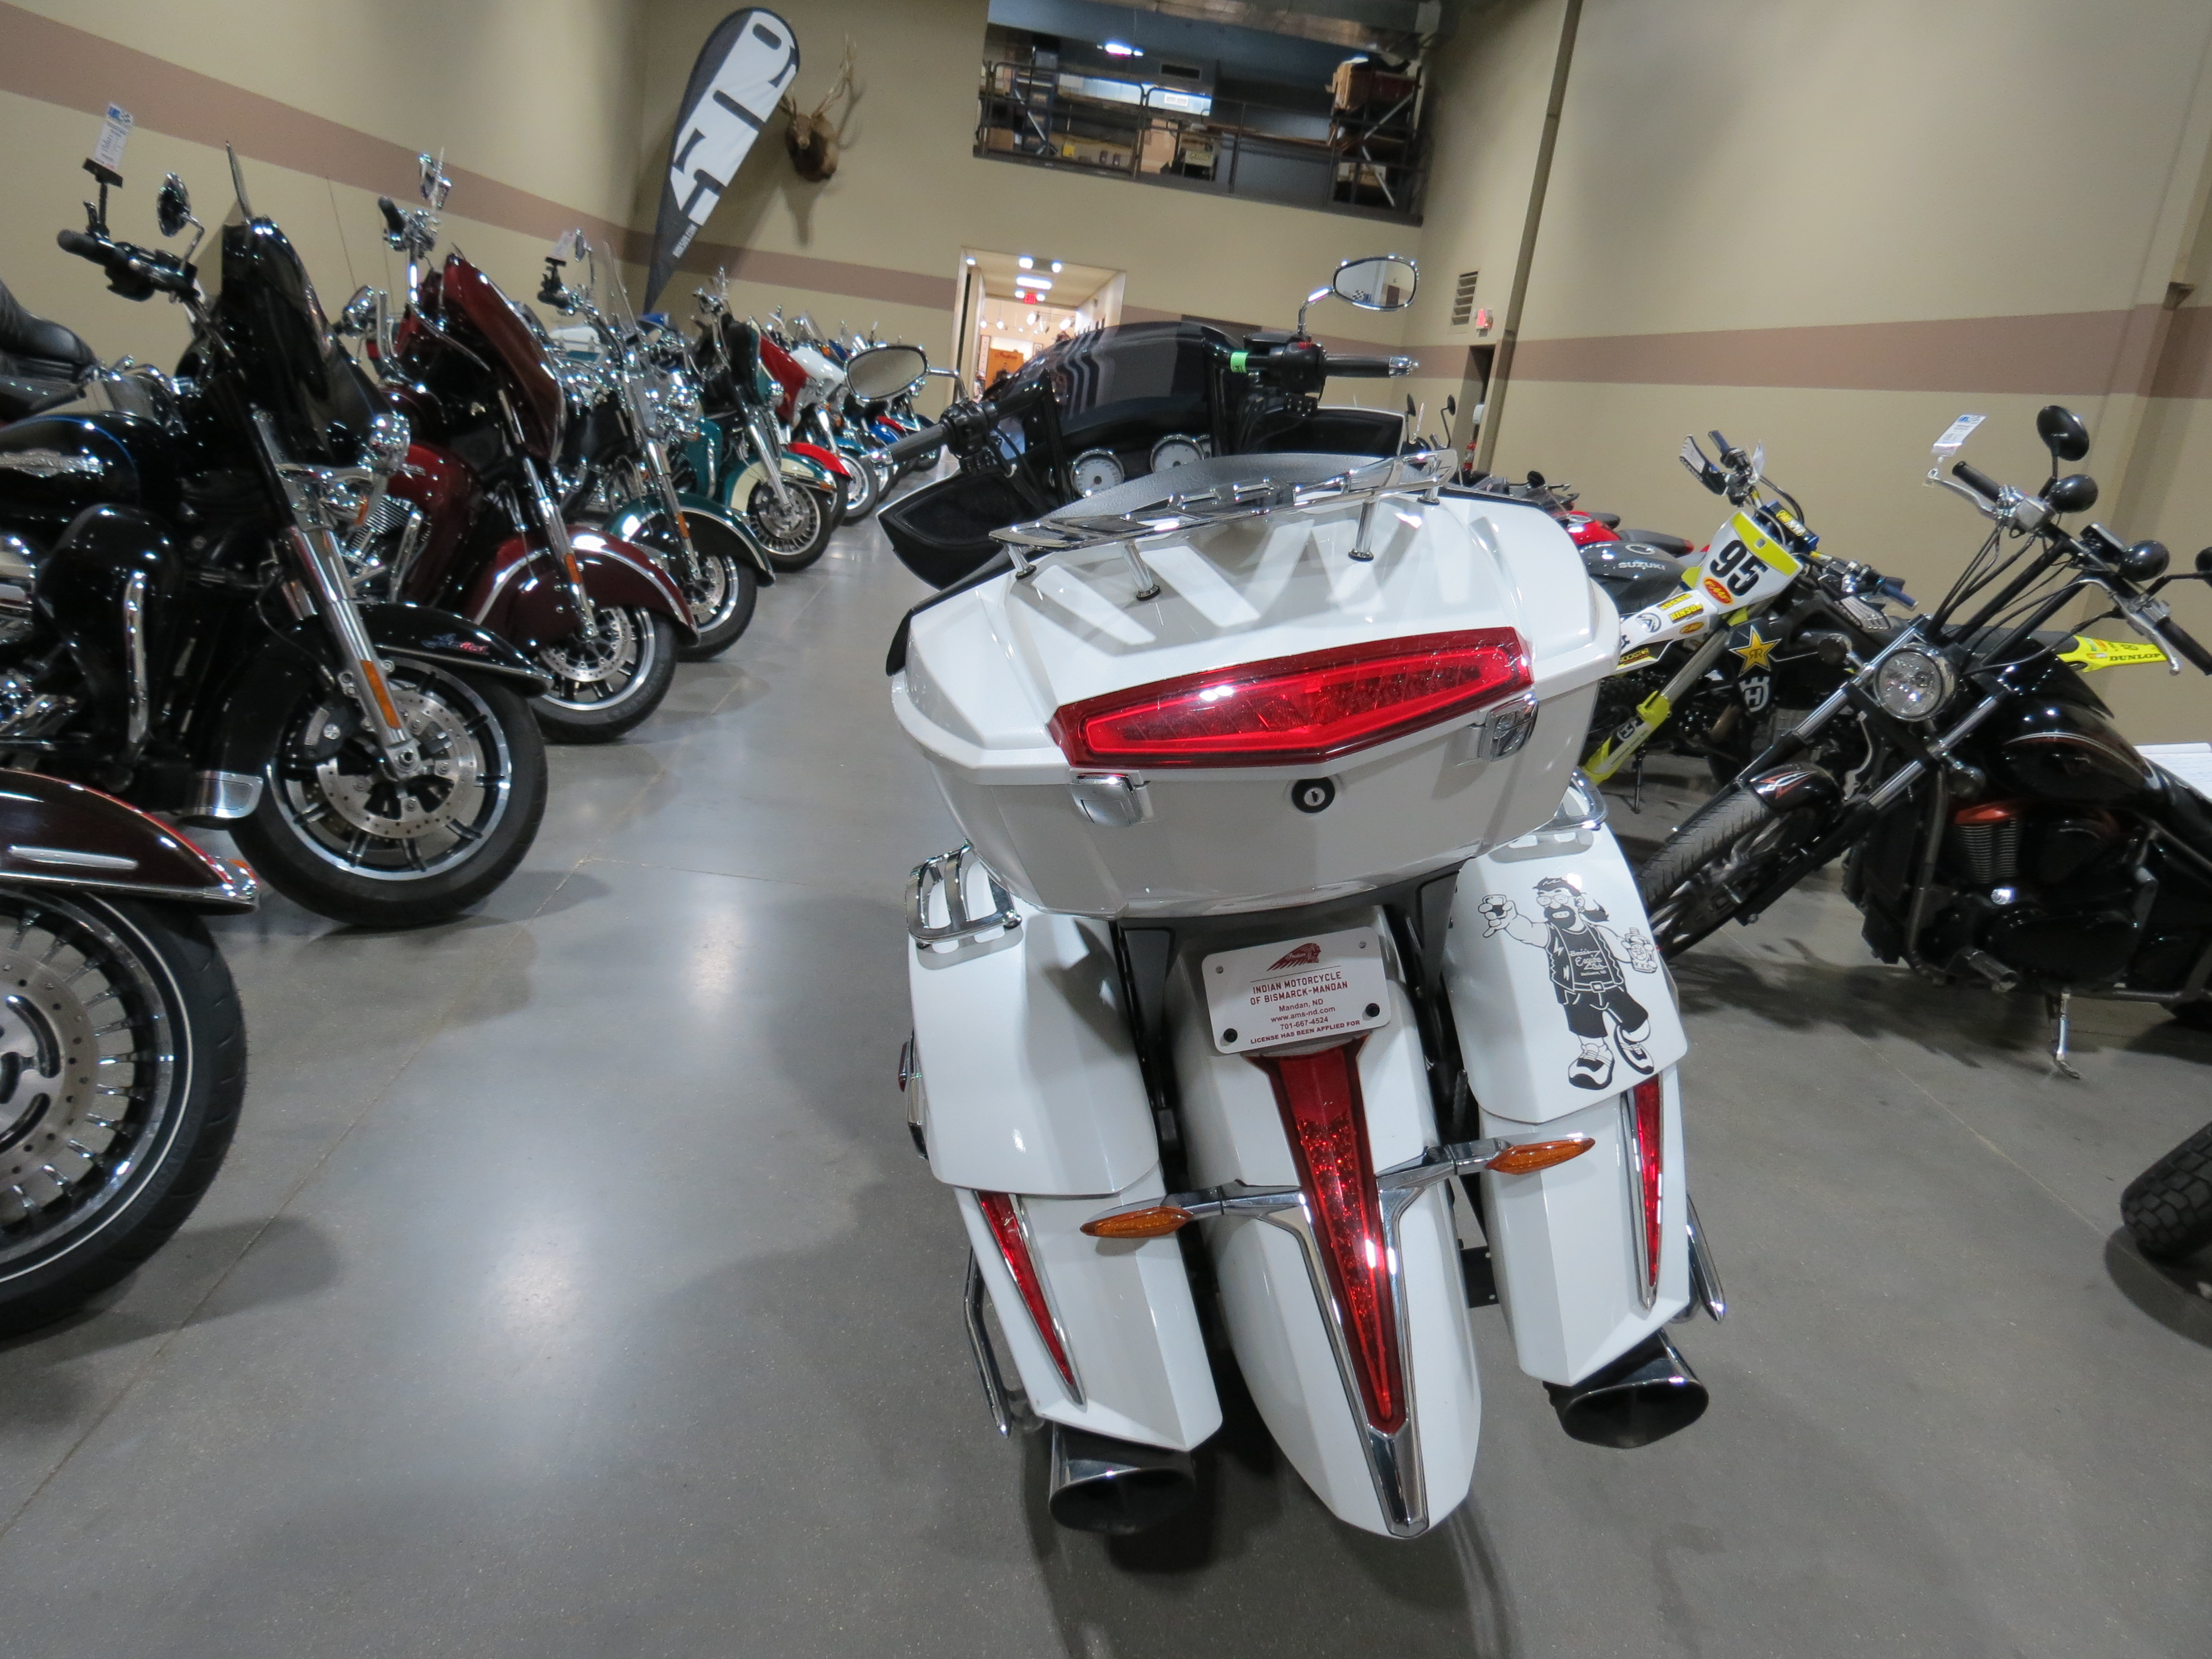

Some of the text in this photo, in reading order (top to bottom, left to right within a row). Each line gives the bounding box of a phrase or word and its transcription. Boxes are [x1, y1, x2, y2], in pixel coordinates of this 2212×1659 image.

[1618, 561, 1666, 570] SUZUKI
[1710, 540, 1769, 597] 95
[1669, 603, 1703, 621] HINSON
[2109, 653, 2161, 661] DUNLOP
[1253, 971, 1342, 994] INDIAN MOTORCYCLE
[1250, 981, 1348, 1005] OF BISMARCK-MANDAN
[1279, 998, 1323, 1012] Mandan, ND
[1270, 1006, 1335, 1022] www.ams-nd.com
[1280, 1016, 1328, 1030] 701-667-4524
[1250, 1034, 1279, 1044] LICENSE
[1297, 1027, 1314, 1036] BEEN
[1317, 1022, 1345, 1032] APPLIED
